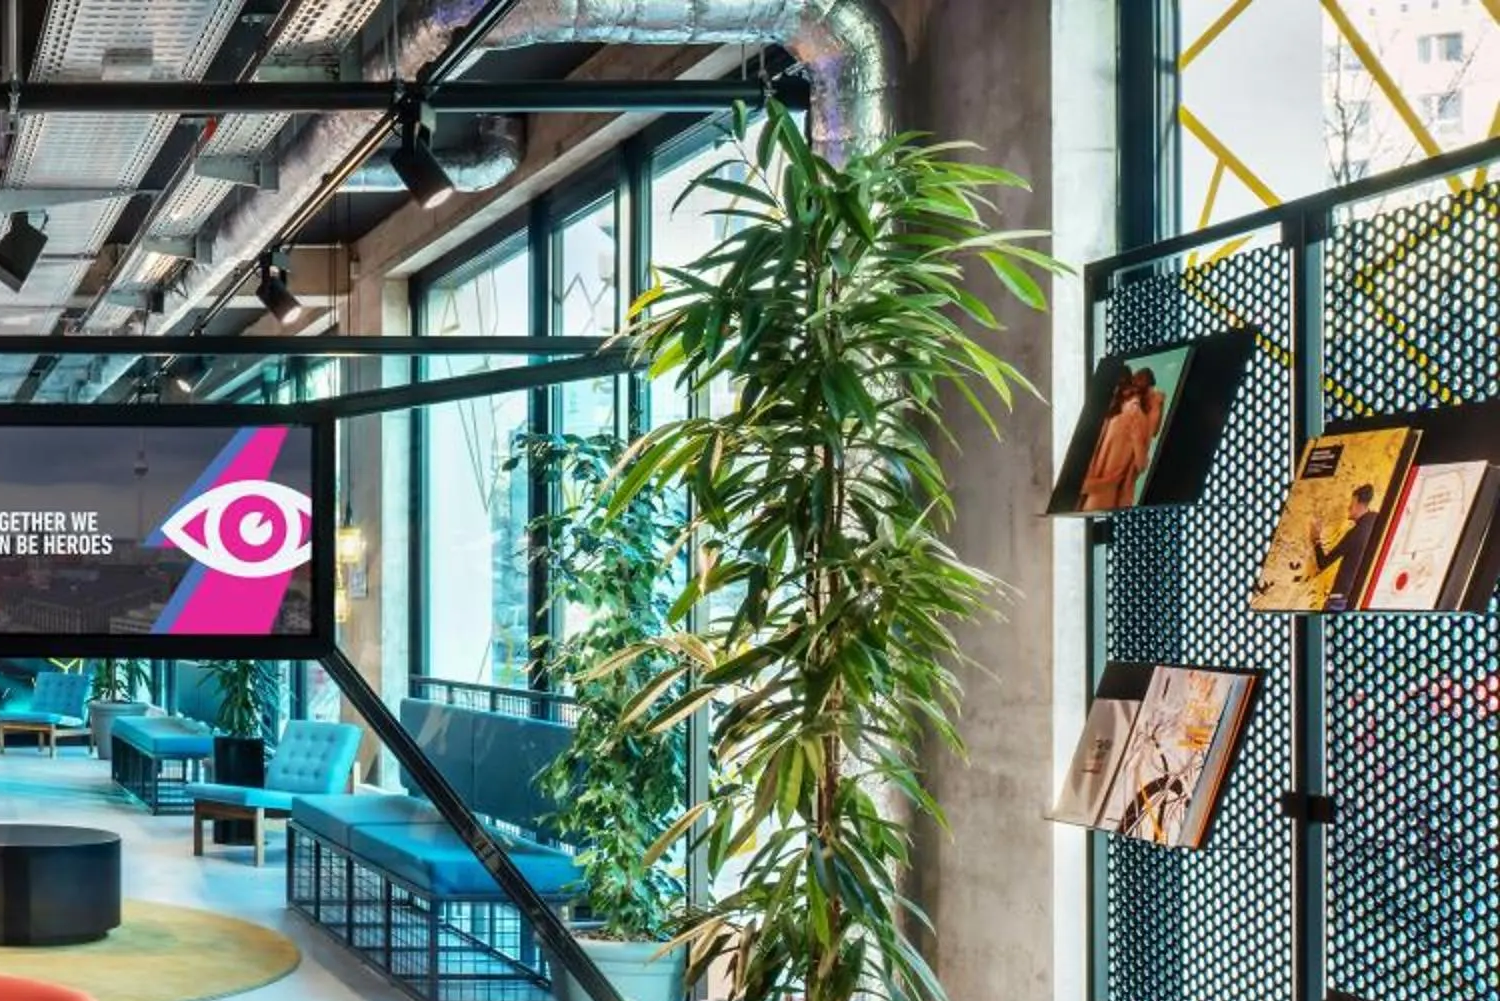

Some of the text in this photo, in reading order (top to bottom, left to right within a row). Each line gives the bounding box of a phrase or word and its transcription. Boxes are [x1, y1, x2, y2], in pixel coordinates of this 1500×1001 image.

[71, 511, 99, 532] WE
[17, 534, 39, 555] BE
[44, 534, 113, 555] HEROES
